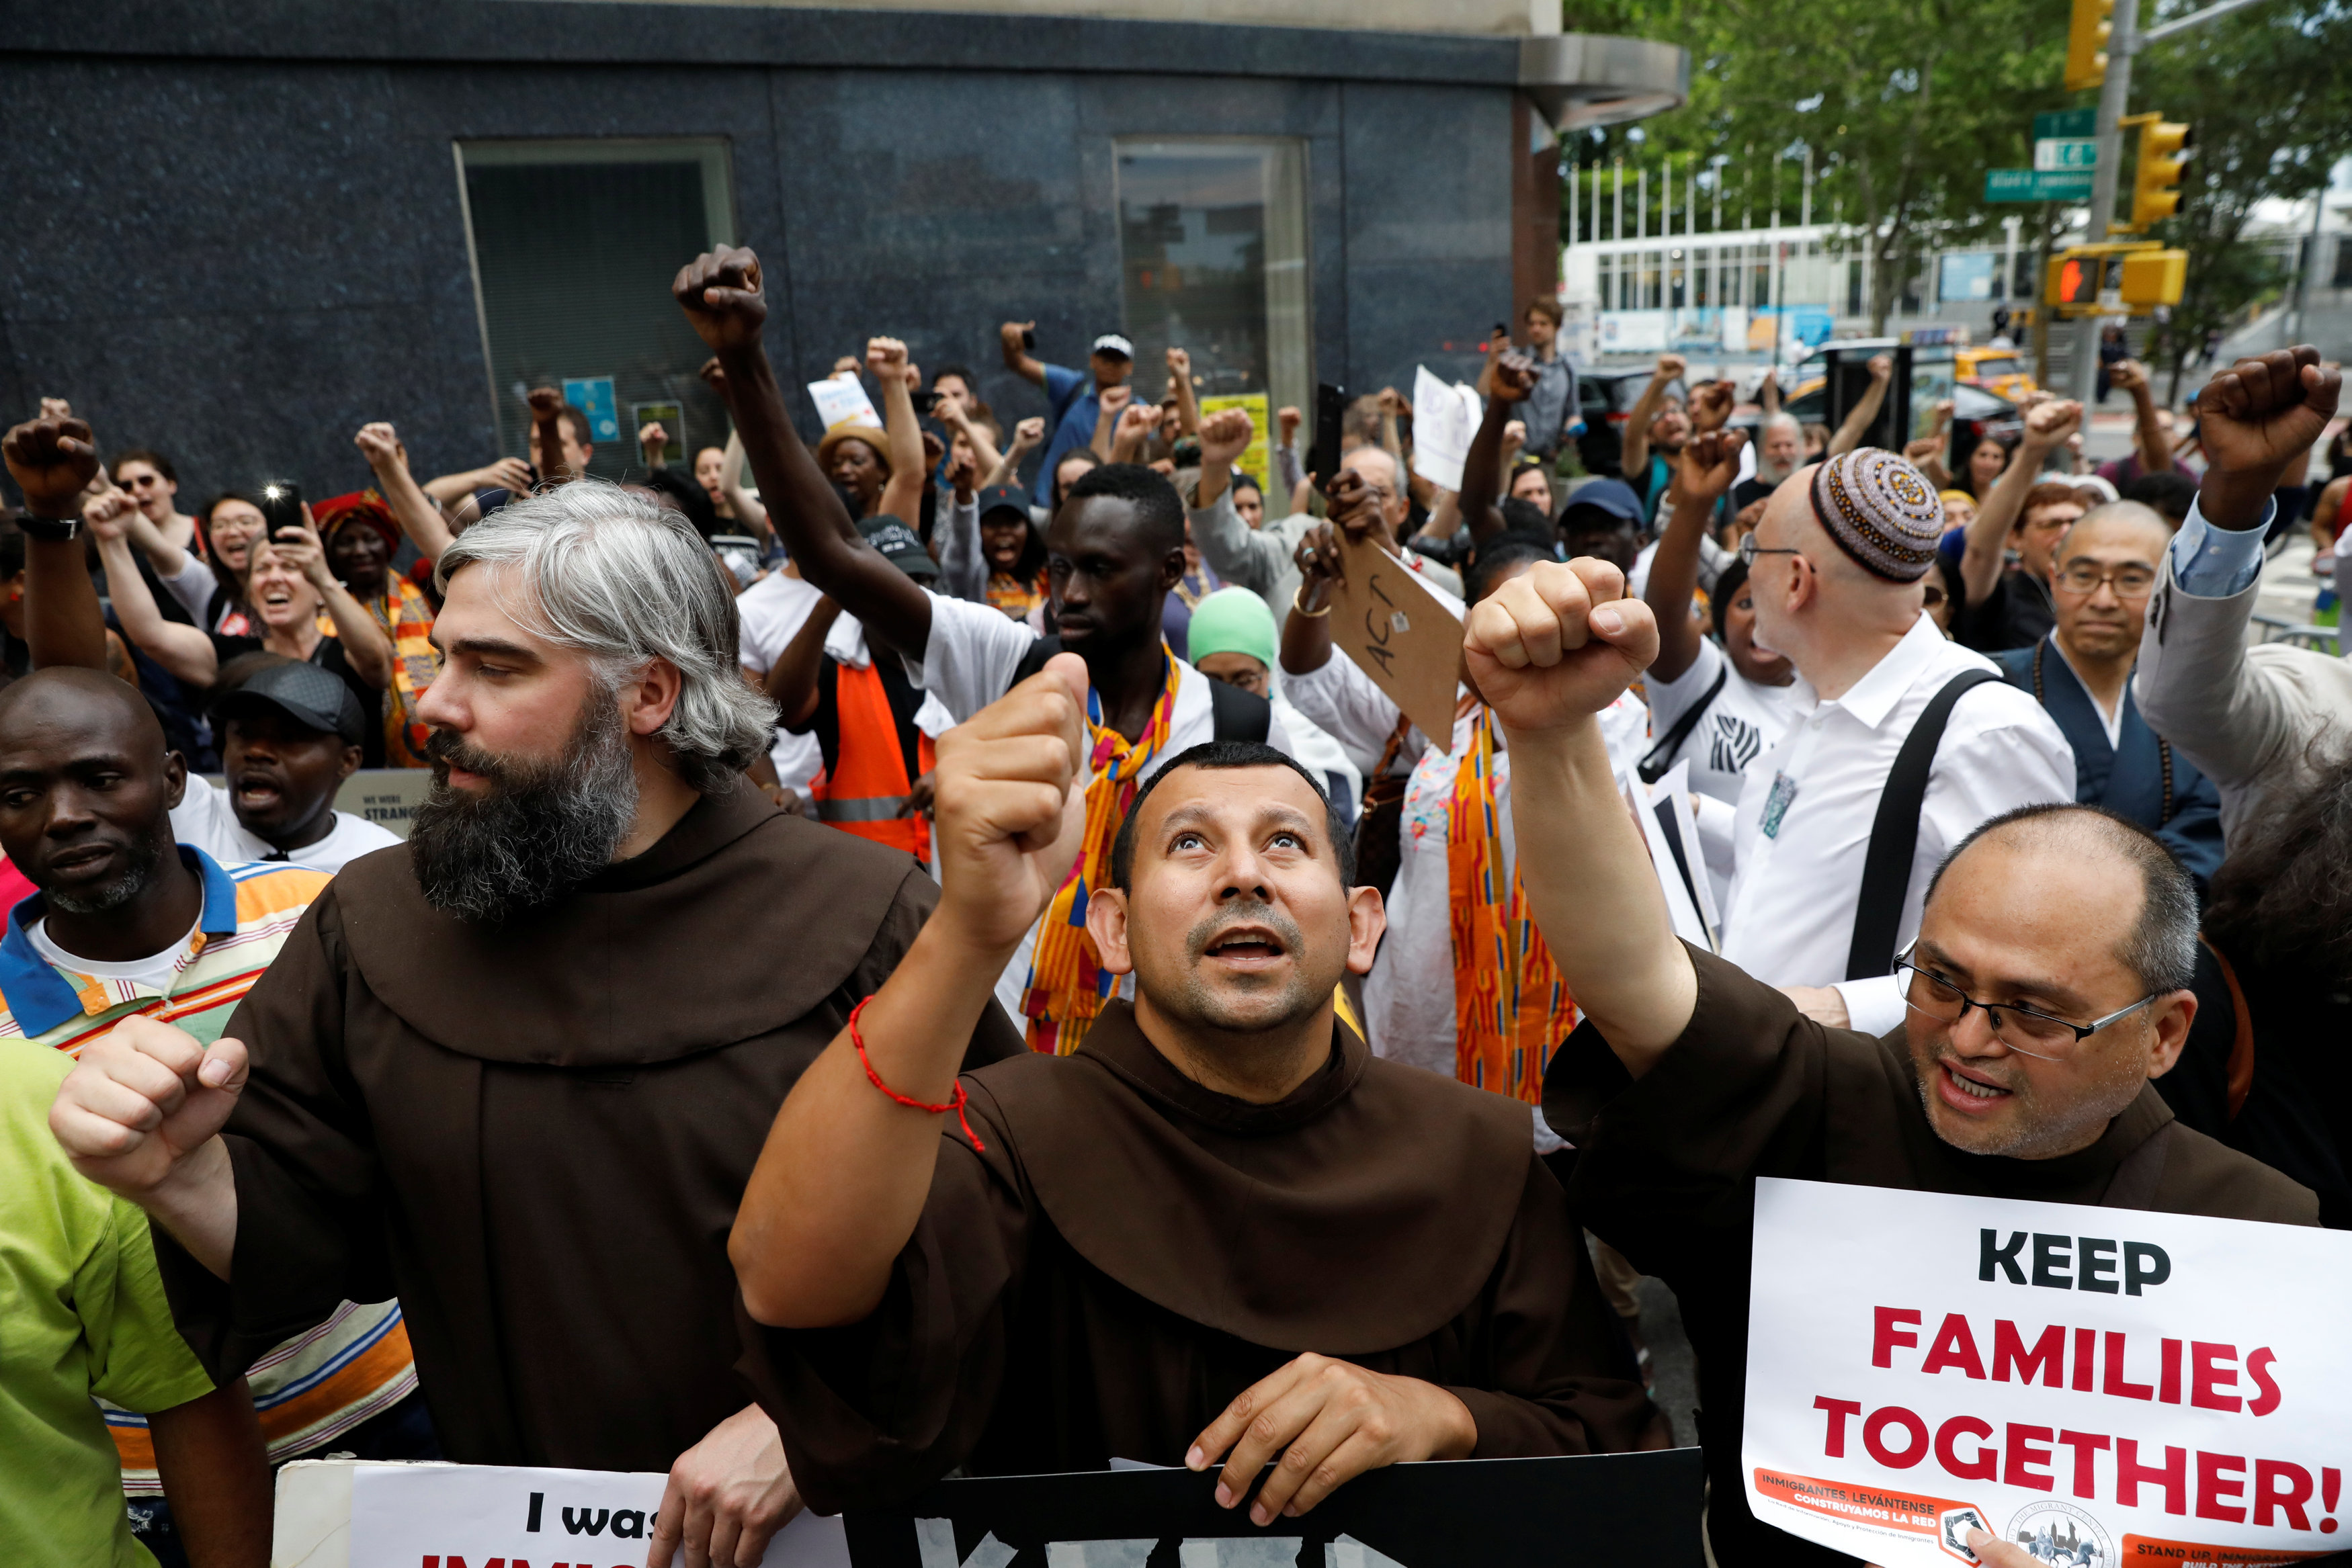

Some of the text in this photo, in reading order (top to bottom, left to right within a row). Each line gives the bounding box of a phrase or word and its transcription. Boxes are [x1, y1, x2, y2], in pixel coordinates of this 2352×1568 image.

[1366, 574, 1394, 678] ACT
[1978, 1228, 2171, 1297] KEEP
[1872, 1305, 2281, 1417] FAMILIES
[1814, 1395, 2341, 1534] TOGETHER!
[526, 1491, 544, 1532] I
[1763, 1475, 1935, 1516] INMIGRANTES, LEVÁNTENSE
[1794, 1493, 1937, 1528] CONSTRUYAMOS LA RED
[1832, 1519, 1851, 1530] Apoyo
[1898, 1533, 1934, 1544] Inmigrantes
[2015, 1503, 2107, 1540] THE MIGRANT CENTER
[2137, 1544, 2185, 1558] STAND
